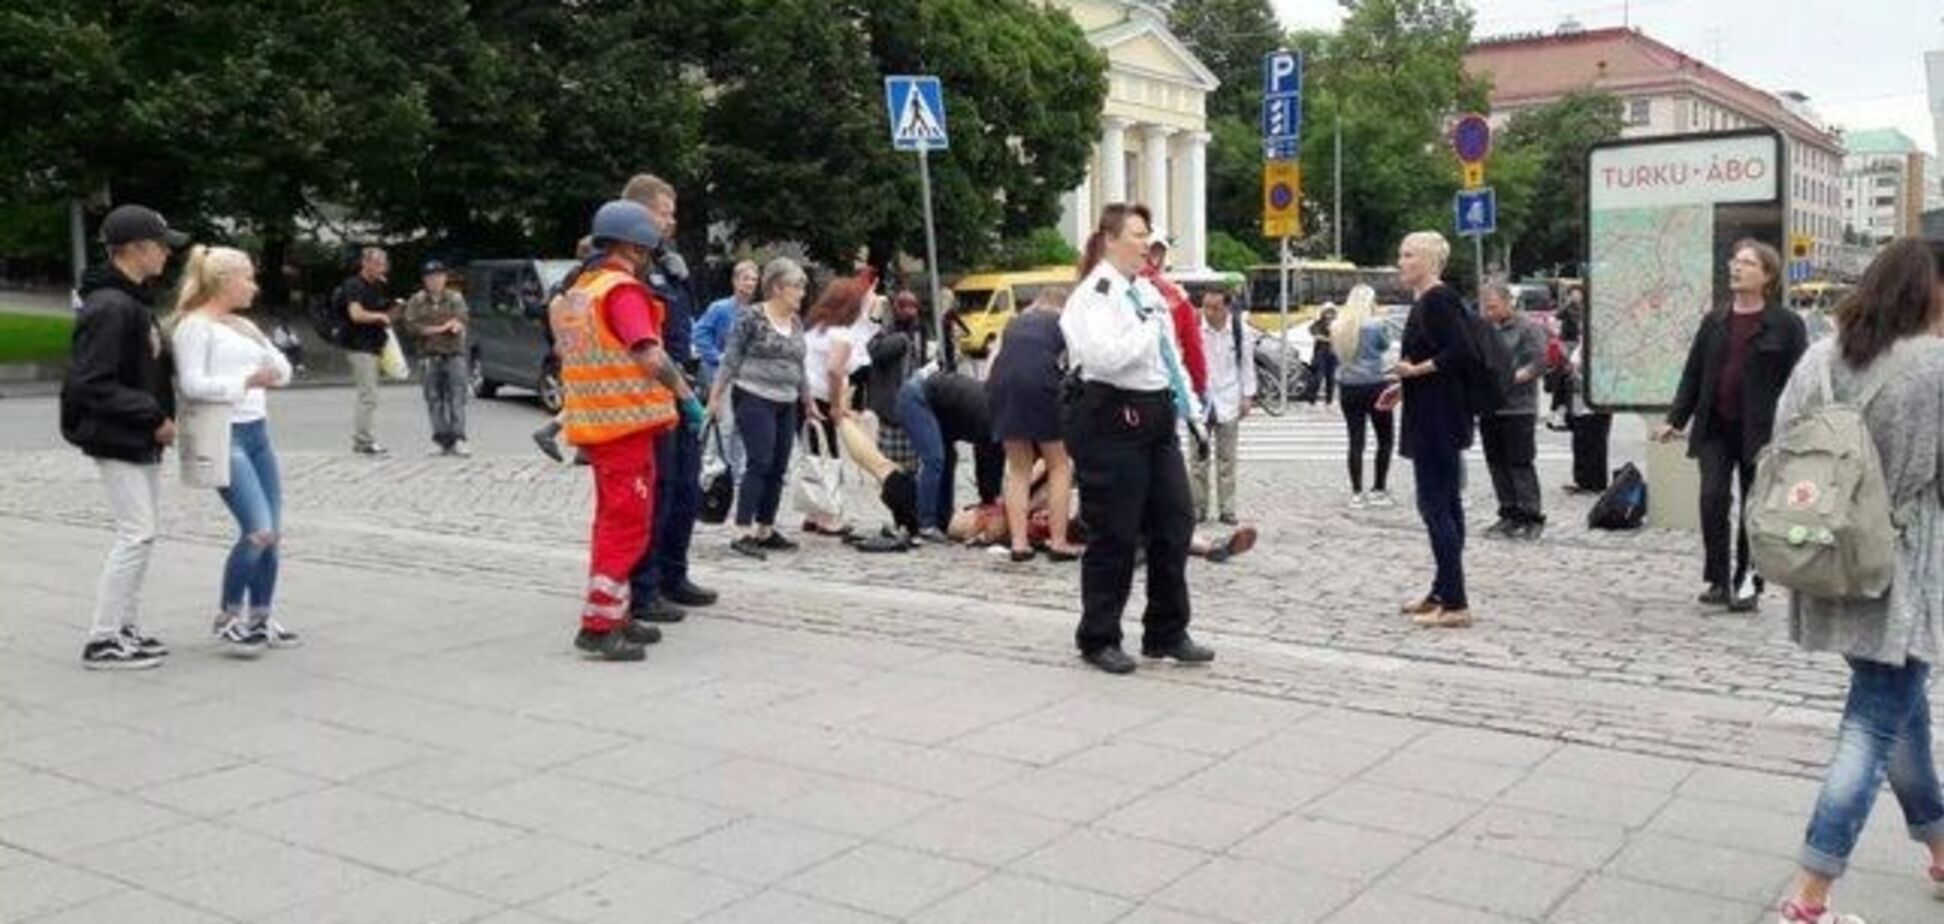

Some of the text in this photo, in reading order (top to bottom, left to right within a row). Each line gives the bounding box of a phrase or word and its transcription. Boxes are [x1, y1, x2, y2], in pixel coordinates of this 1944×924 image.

[1272, 56, 1294, 91] P
[1602, 154, 1766, 189] TURKU ÅBO
